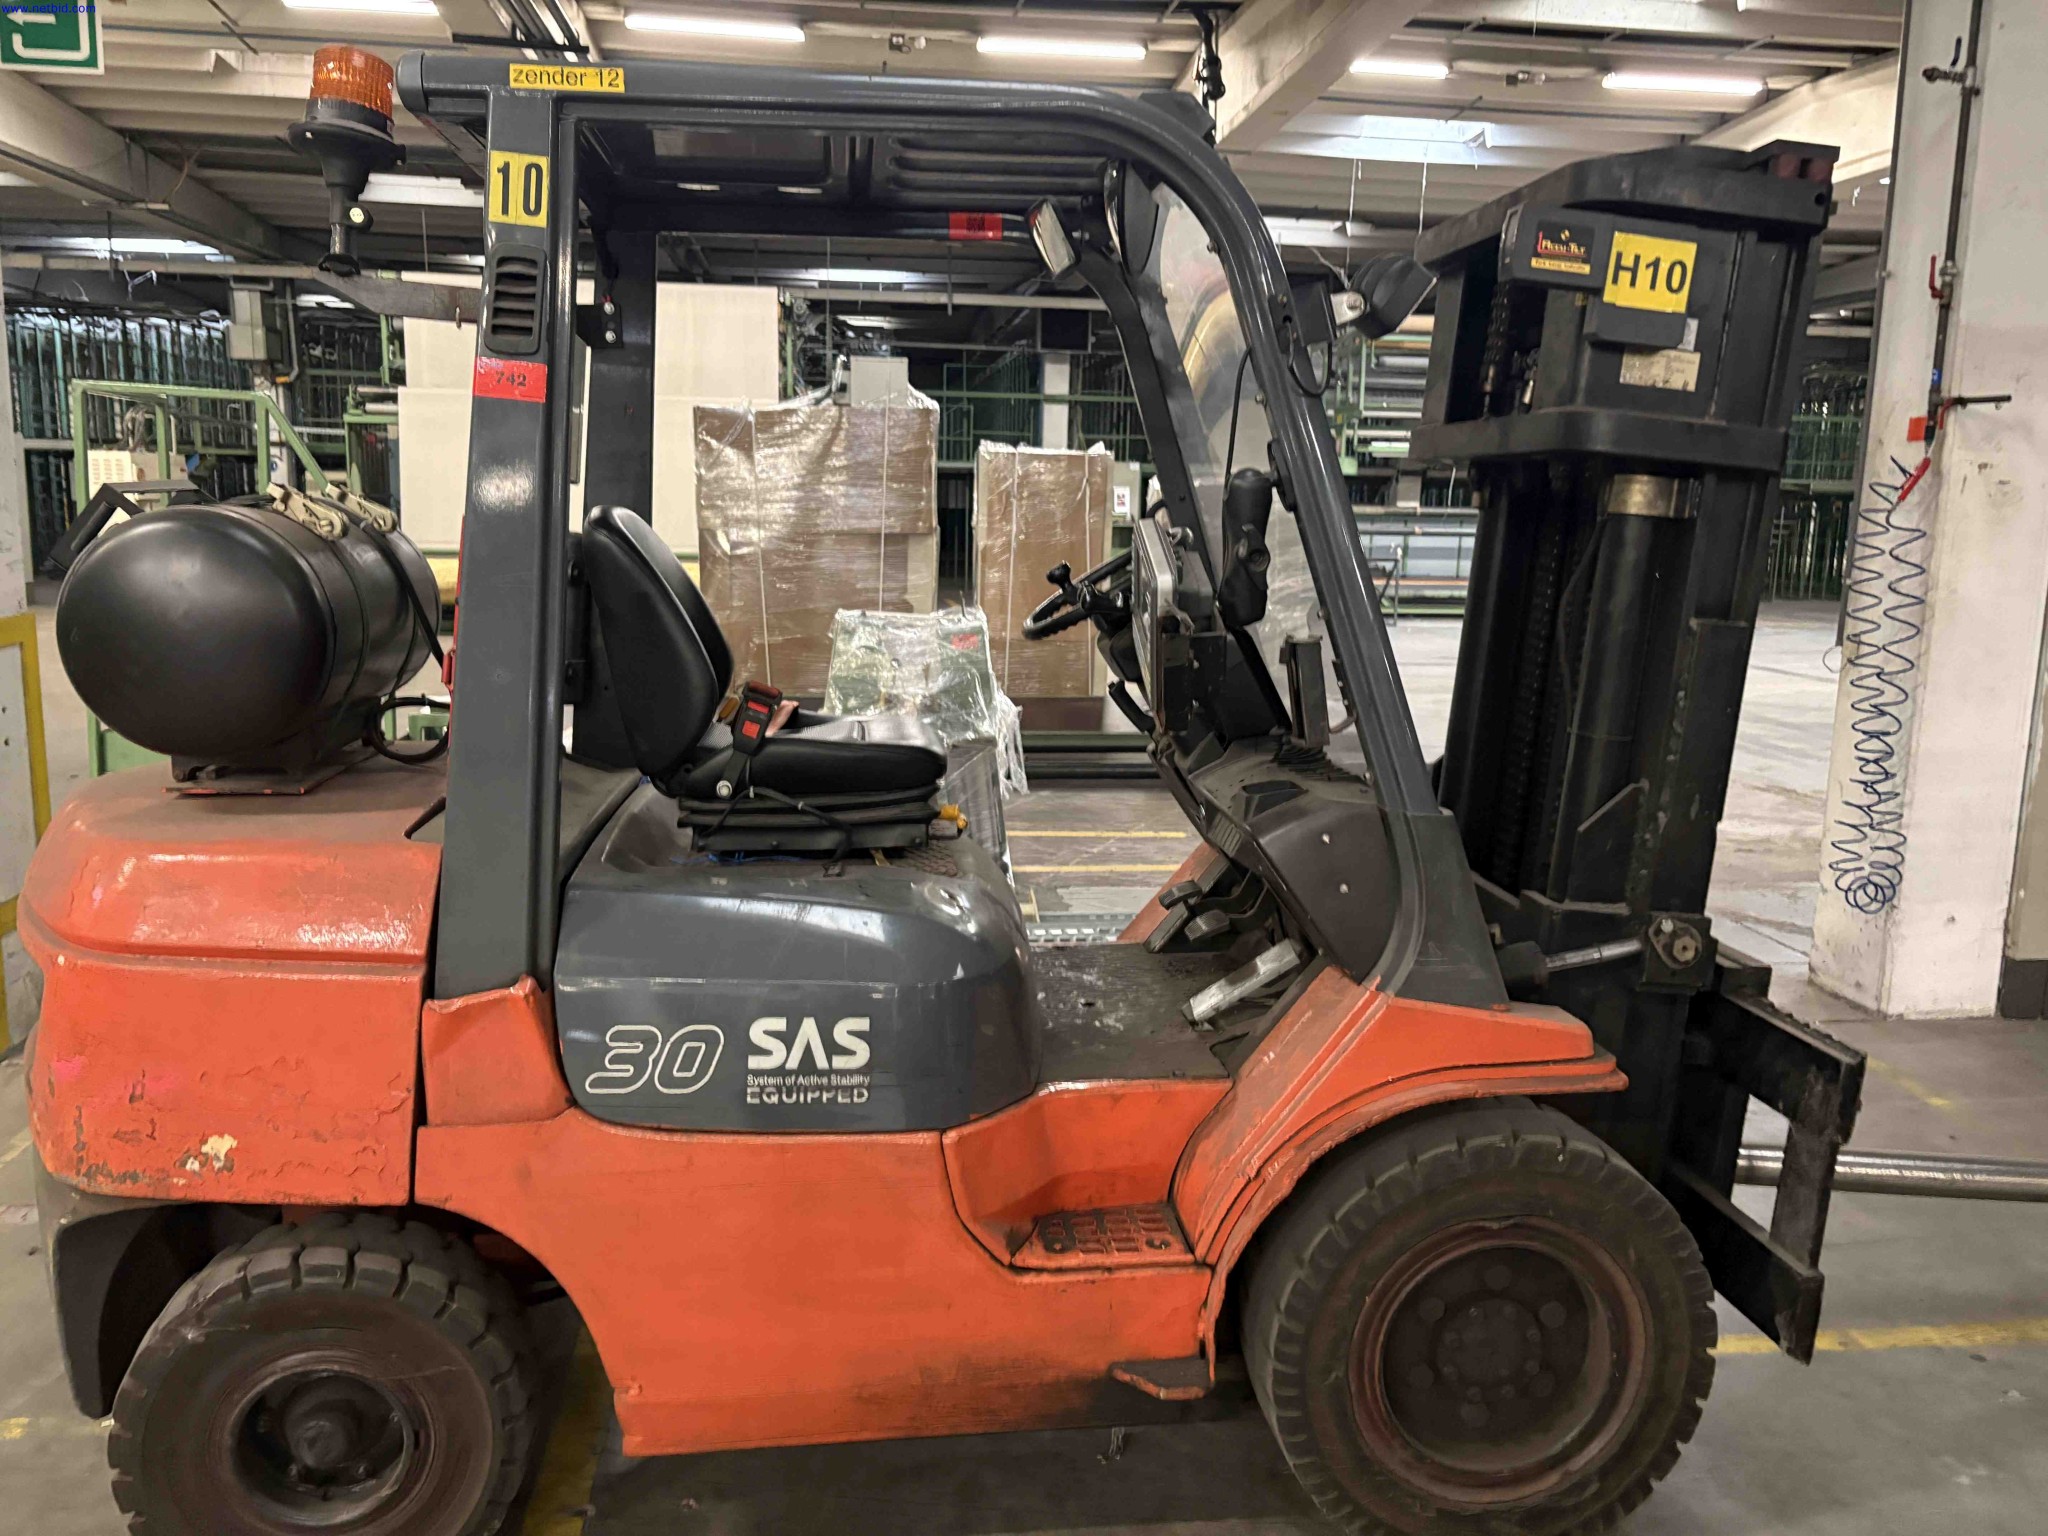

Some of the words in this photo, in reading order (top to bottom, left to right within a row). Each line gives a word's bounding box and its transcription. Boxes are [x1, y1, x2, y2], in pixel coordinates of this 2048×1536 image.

[512, 66, 588, 87] zender
[595, 68, 620, 88] 12
[496, 160, 544, 217] 10
[1611, 250, 1688, 295] H10
[495, 370, 527, 387] 742
[584, 1024, 725, 1094] 30
[747, 1016, 871, 1070] SAS
[746, 1086, 870, 1105] EQUIPPED
[747, 1073, 784, 1088] System
[785, 1073, 796, 1087] of
[797, 1073, 829, 1087] Active
[830, 1073, 871, 1088] Stability
